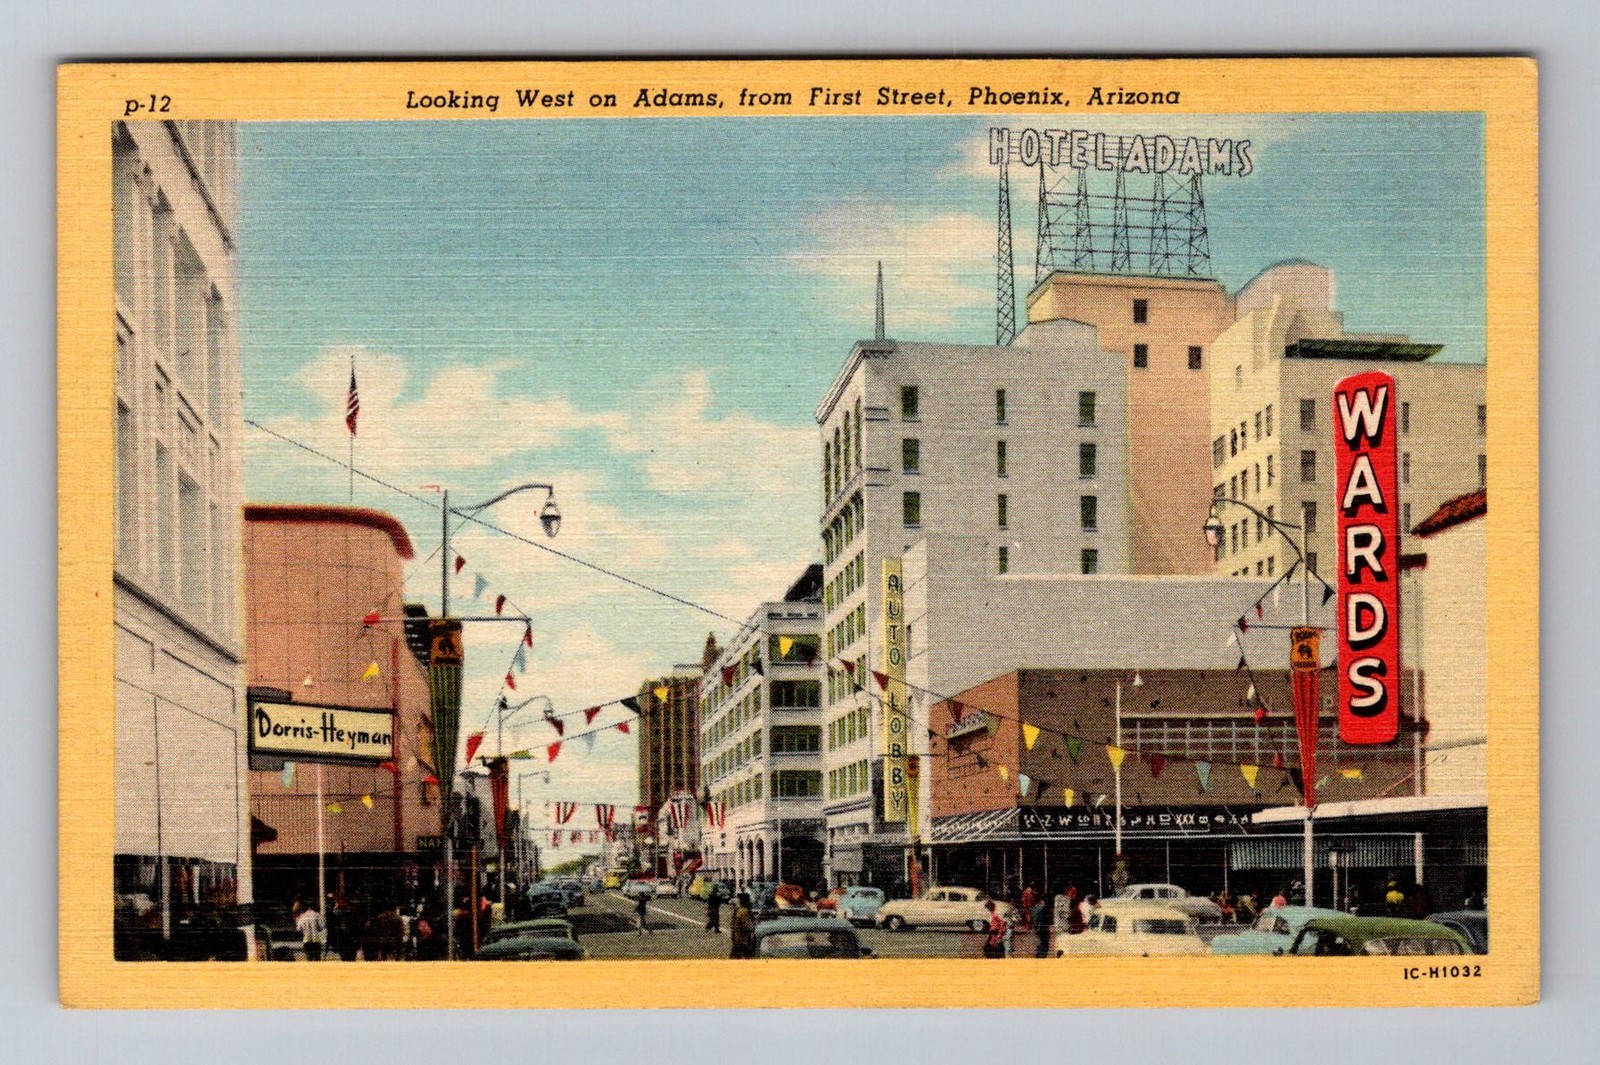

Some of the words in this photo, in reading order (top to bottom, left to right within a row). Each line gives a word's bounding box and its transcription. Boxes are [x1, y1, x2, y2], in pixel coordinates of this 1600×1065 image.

[123, 94, 171, 116] p-12
[406, 90, 500, 112] Looking
[515, 89, 574, 108] West
[589, 94, 617, 107] on
[633, 88, 724, 109] Adams,
[739, 88, 792, 107] from
[808, 87, 862, 106] First
[876, 86, 952, 108] Street,
[967, 86, 1070, 108] Phoenix,
[1086, 87, 1181, 106] Arizona
[989, 127, 1113, 171] HOTEL
[1125, 133, 1253, 178] ADAMS
[1335, 385, 1388, 716] WARDS
[888, 574, 902, 666] AUTO
[255, 706, 391, 750] Dorris-Heyman
[889, 692, 904, 808] LOBBY
